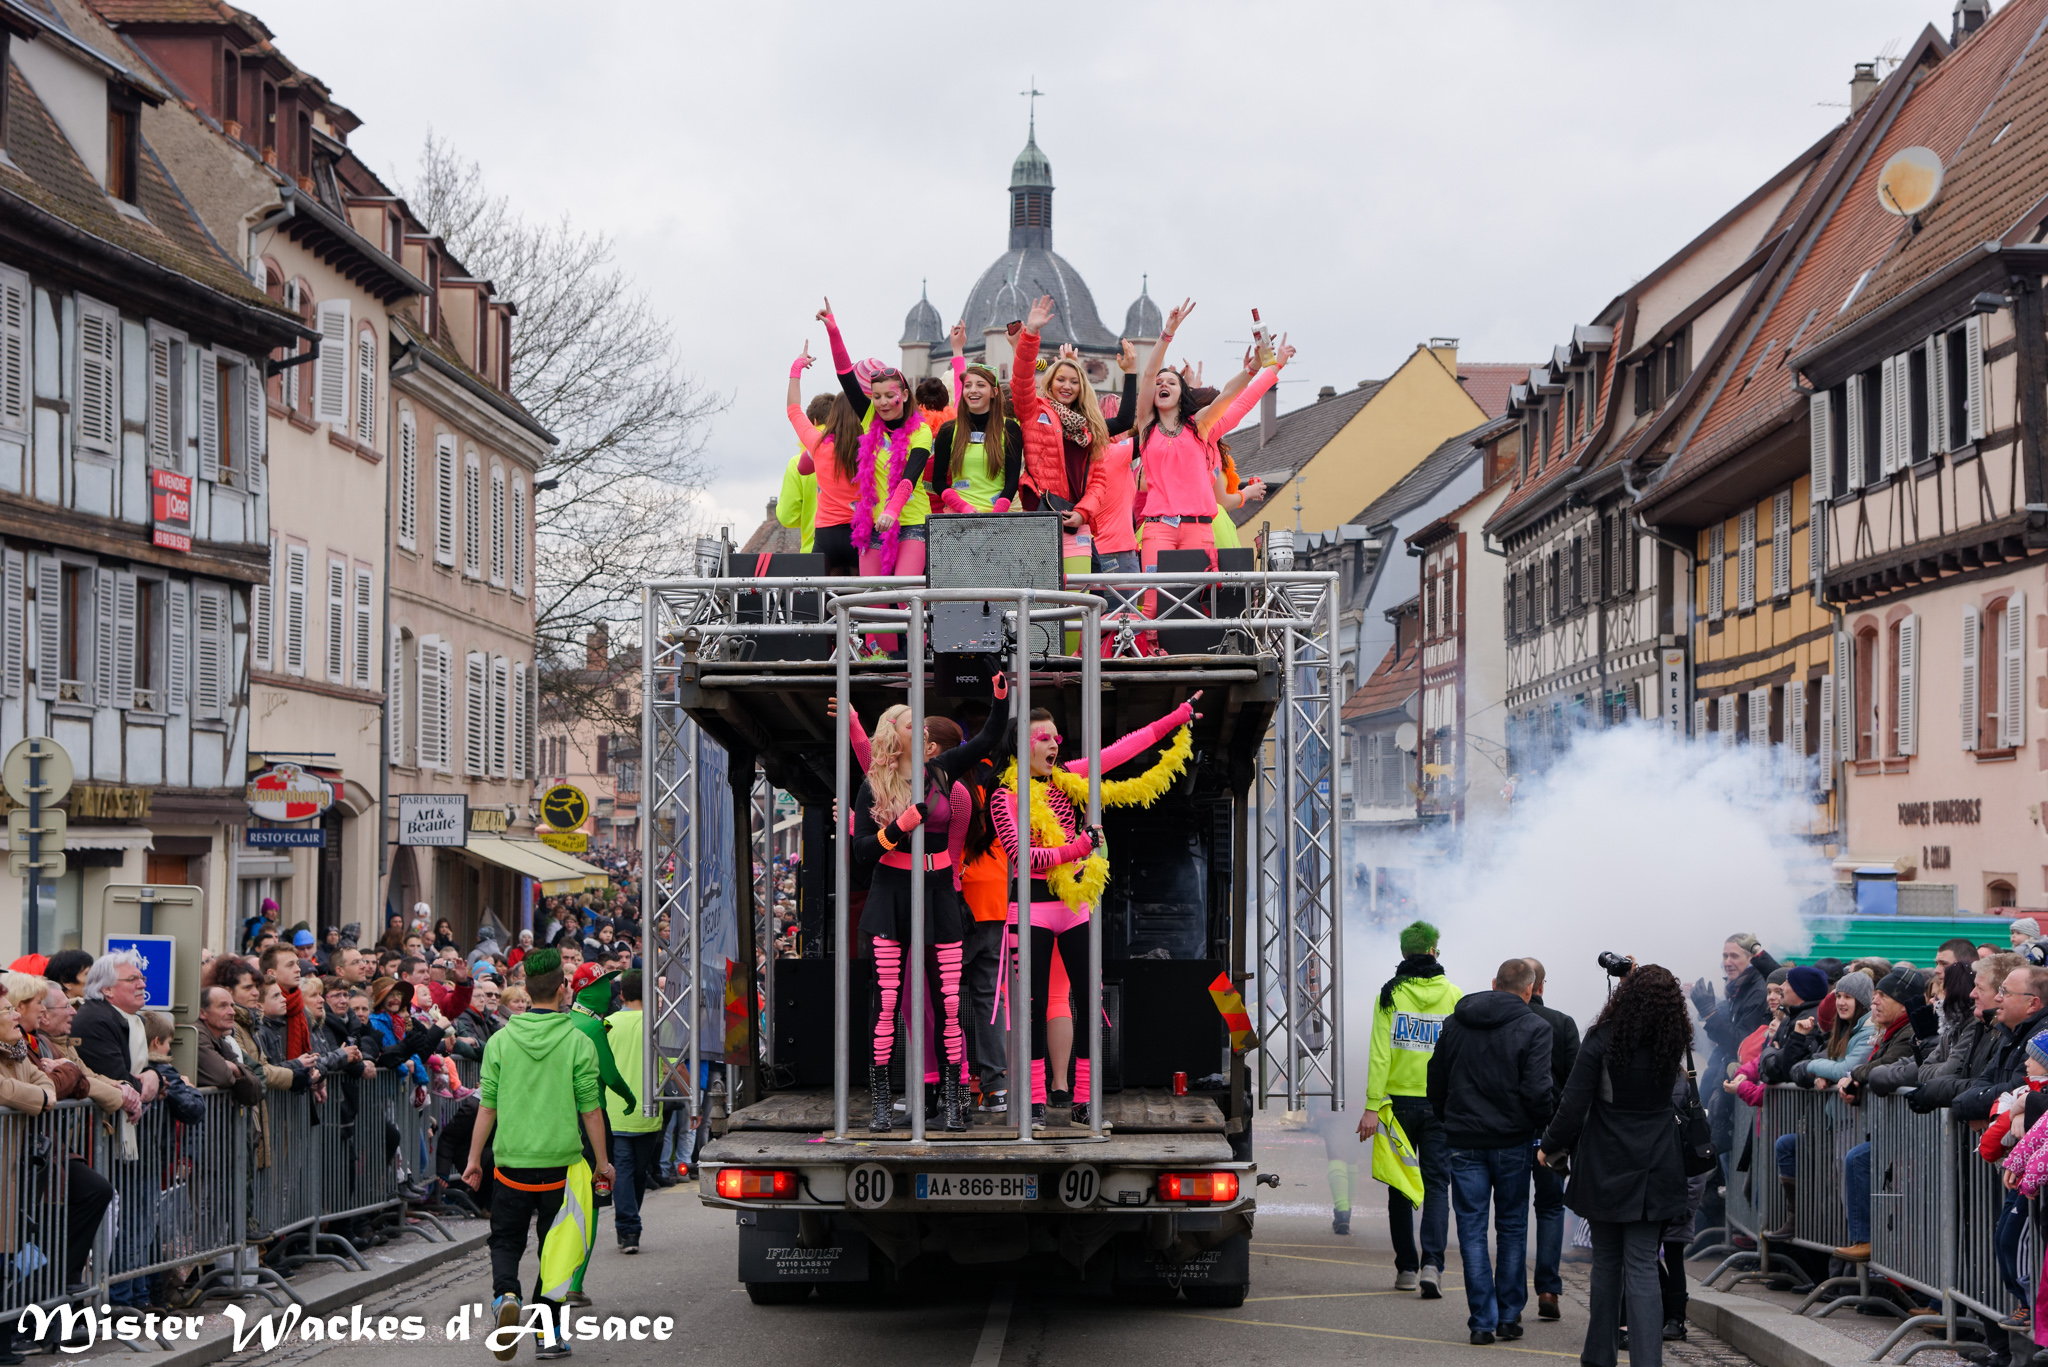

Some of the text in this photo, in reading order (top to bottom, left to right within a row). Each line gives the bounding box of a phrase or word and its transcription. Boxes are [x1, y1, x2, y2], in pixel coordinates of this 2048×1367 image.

[164, 473, 187, 493] VENDRE
[247, 784, 329, 807] Kronenbourg
[401, 796, 464, 805] PARFUMERIE
[414, 808, 444, 821] Art &
[407, 815, 456, 834] Beauté
[250, 832, 320, 844] RESTO'ECLAIR
[408, 836, 455, 844] INSTITUT
[855, 1169, 886, 1203] 80
[929, 1178, 1024, 1196] AA-866-BH
[1026, 1188, 1036, 1197] 67
[1065, 1169, 1094, 1202] 90
[766, 1247, 843, 1260] FIAULT
